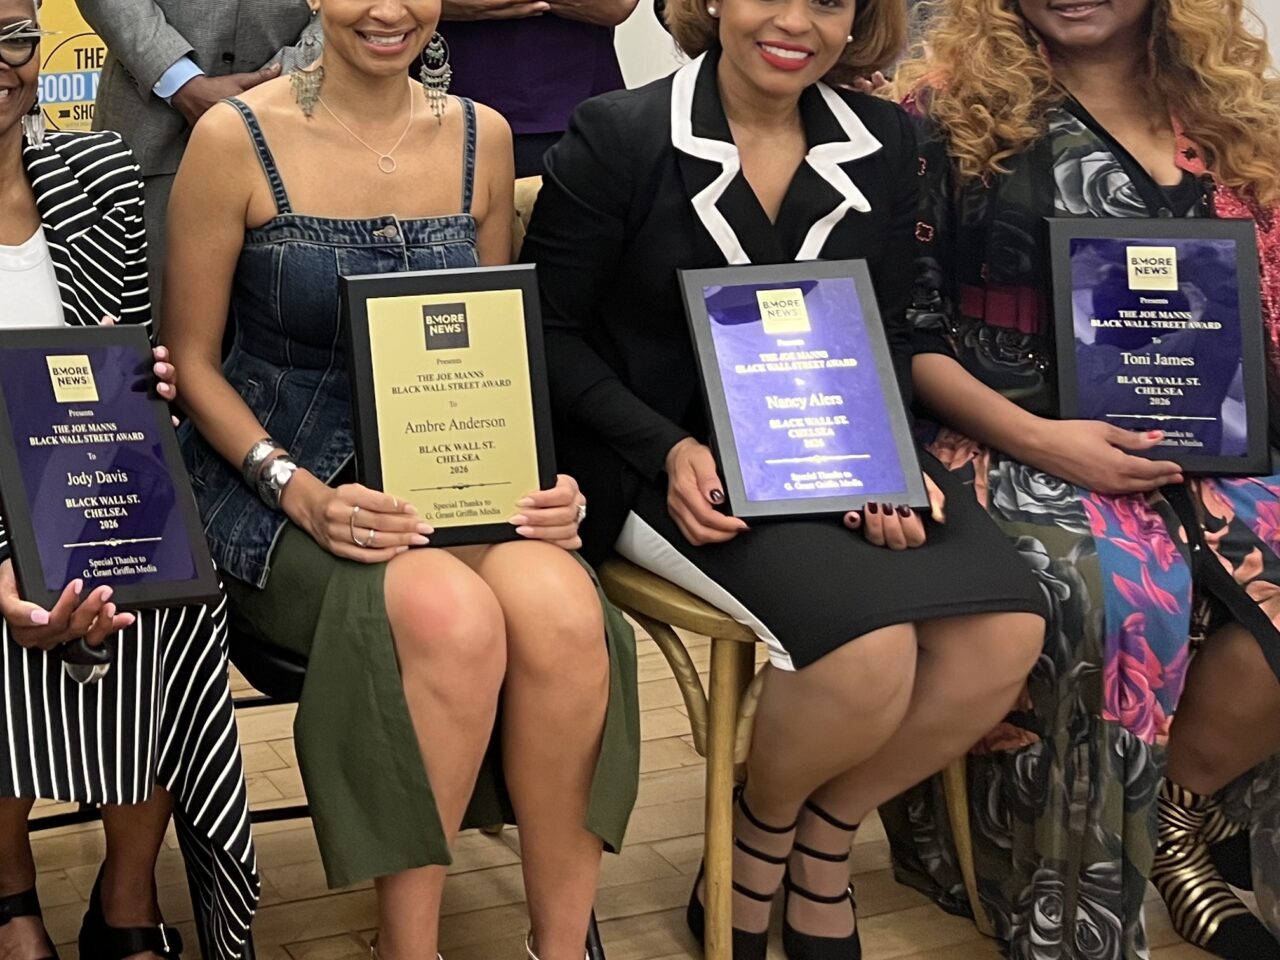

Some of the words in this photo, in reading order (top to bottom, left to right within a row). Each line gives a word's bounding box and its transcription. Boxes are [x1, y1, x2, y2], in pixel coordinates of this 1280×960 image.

[74, 48, 104, 69] THE
[74, 104, 95, 120] SHO
[1135, 267, 1168, 276] NEWS
[1118, 310, 1138, 319] THE
[1139, 311, 1157, 319] JOE
[1159, 311, 1192, 320] MANNS
[429, 324, 461, 336] NEWS
[1091, 320, 1123, 328] BLACK
[1124, 320, 1150, 329] WALL
[1151, 321, 1187, 329] STREET
[1188, 321, 1222, 330] AWARD
[1120, 353, 1151, 366] Toni
[1154, 353, 1195, 367] James
[58, 376, 87, 387] NEWS
[417, 374, 434, 382] THE
[436, 372, 453, 381] JOE
[454, 371, 484, 380] MANNS
[1117, 376, 1153, 385] BLACK
[1155, 377, 1185, 386] WALL
[1186, 377, 1201, 386] ST.
[392, 385, 421, 395] BLACK
[422, 383, 447, 393] WALL
[447, 381, 480, 391] STREET
[481, 379, 512, 389] AWARD
[1135, 387, 1184, 396] CHELSEA
[766, 395, 807, 410] Nancy
[52, 425, 69, 434] THE
[71, 424, 87, 433] JOE
[88, 423, 117, 432] MANNS
[405, 419, 446, 434] Ambre
[448, 416, 506, 432] Anderson
[29, 436, 58, 446] BLACK
[60, 435, 83, 444] WALL
[83, 433, 115, 443] STREET
[116, 432, 144, 441] AWARD
[419, 444, 452, 454] BLACK
[454, 442, 481, 452] WALL
[482, 441, 496, 450] ST.
[436, 454, 481, 464] CHELSEA
[450, 465, 469, 474] 2026
[67, 472, 93, 488] Jody
[96, 469, 128, 484] Davis
[65, 497, 99, 508] BLACK
[99, 495, 126, 506] WALL
[127, 494, 141, 504] ST.
[84, 507, 128, 519] CHELSEA
[100, 520, 118, 529] 2026
